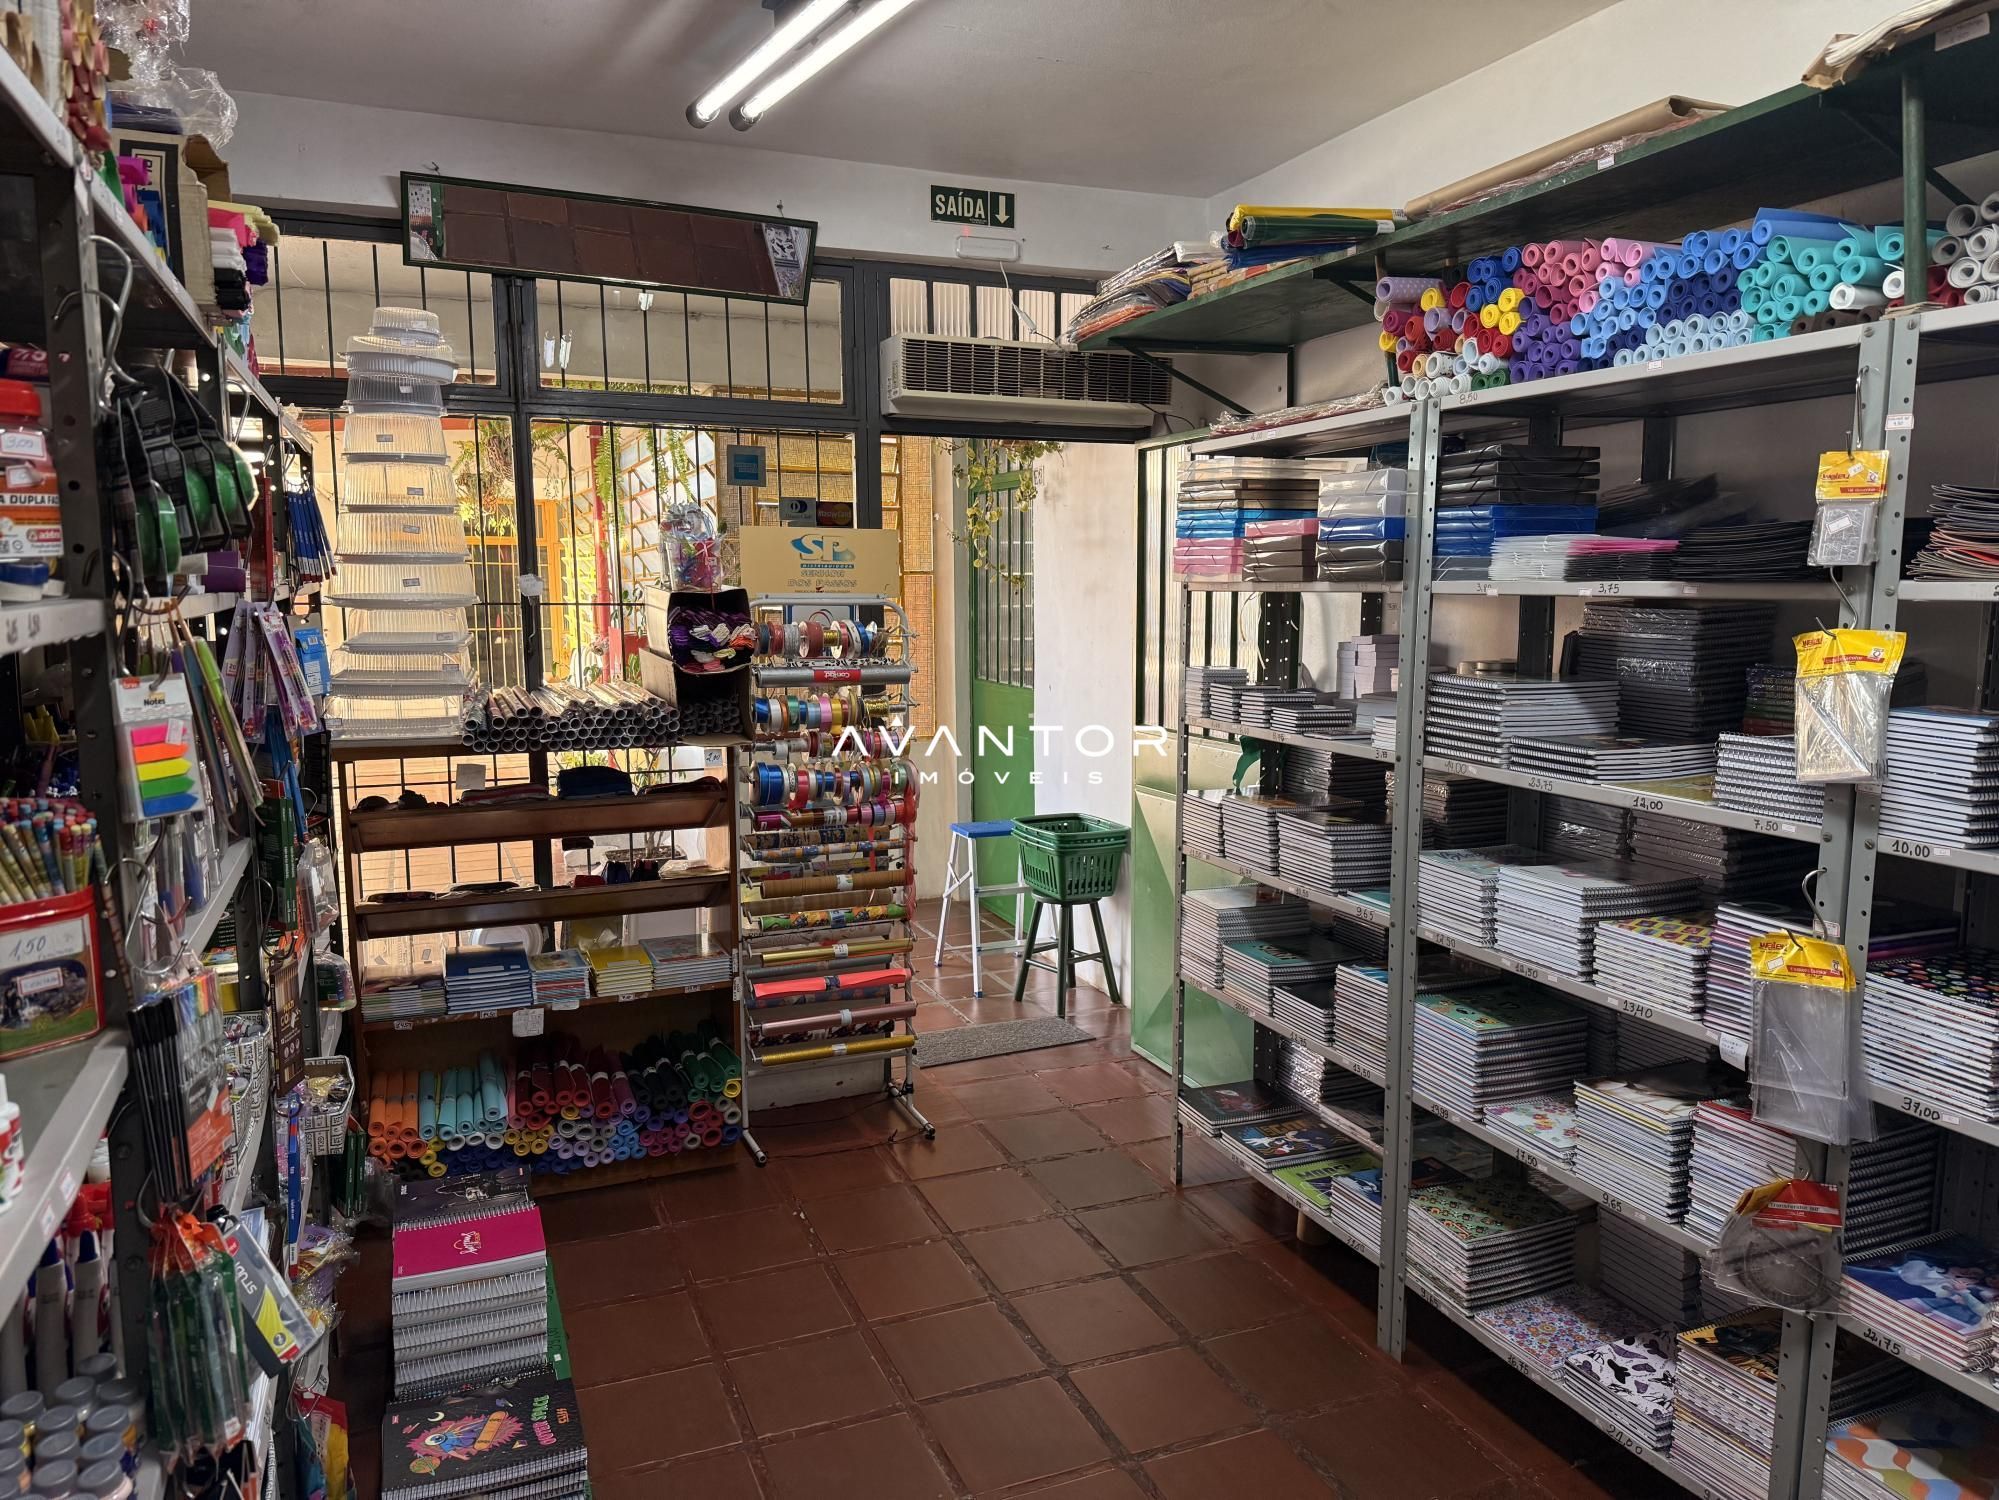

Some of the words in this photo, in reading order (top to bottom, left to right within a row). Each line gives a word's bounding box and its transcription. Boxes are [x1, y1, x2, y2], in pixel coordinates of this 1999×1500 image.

[935, 191, 986, 219] SAÍDA
[9, 494, 47, 505] DUPLA
[1598, 583, 1620, 594] 3,75
[143, 697, 166, 706] Notes
[1527, 776, 1553, 792] 23,75
[1753, 815, 1780, 832] 7,50
[1890, 838, 1931, 858] 10,00
[1355, 906, 1375, 921] 9,65
[1622, 999, 1654, 1019] 13,40
[1602, 1191, 1623, 1213] 9,65
[531, 1394, 550, 1421] SPACE
[532, 1420, 557, 1445] OUTER
